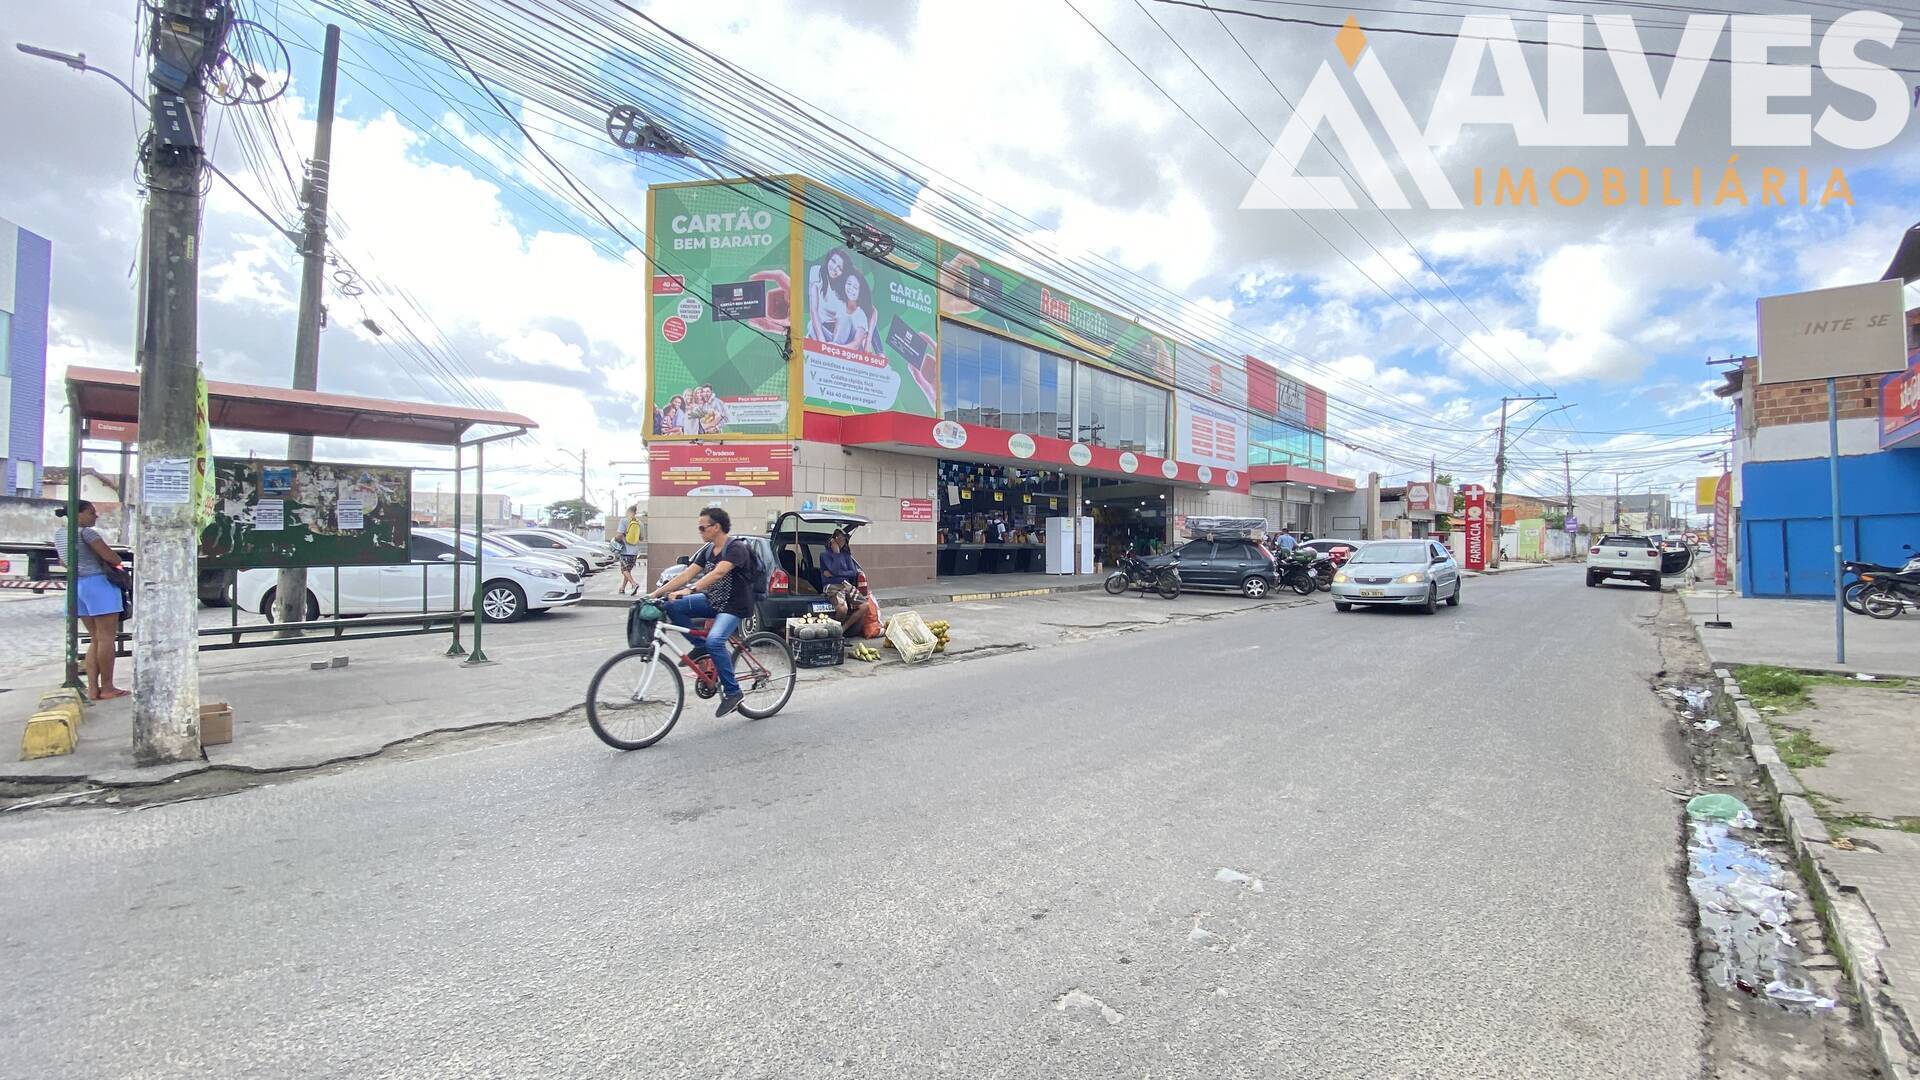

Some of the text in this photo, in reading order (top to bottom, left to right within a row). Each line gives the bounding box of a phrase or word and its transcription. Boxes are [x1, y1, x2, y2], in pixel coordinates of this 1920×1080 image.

[671, 206, 772, 234] CARTÃO
[673, 234, 773, 250] BEM BARATO
[889, 281, 932, 305] CARTÃO
[890, 294, 933, 315] BEM BARATO
[1866, 314, 1891, 328] SE
[821, 343, 841, 355] Peça
[841, 350, 863, 360] agora
[870, 357, 886, 366] seu!
[1466, 522, 1481, 563] FARMÁCIA
